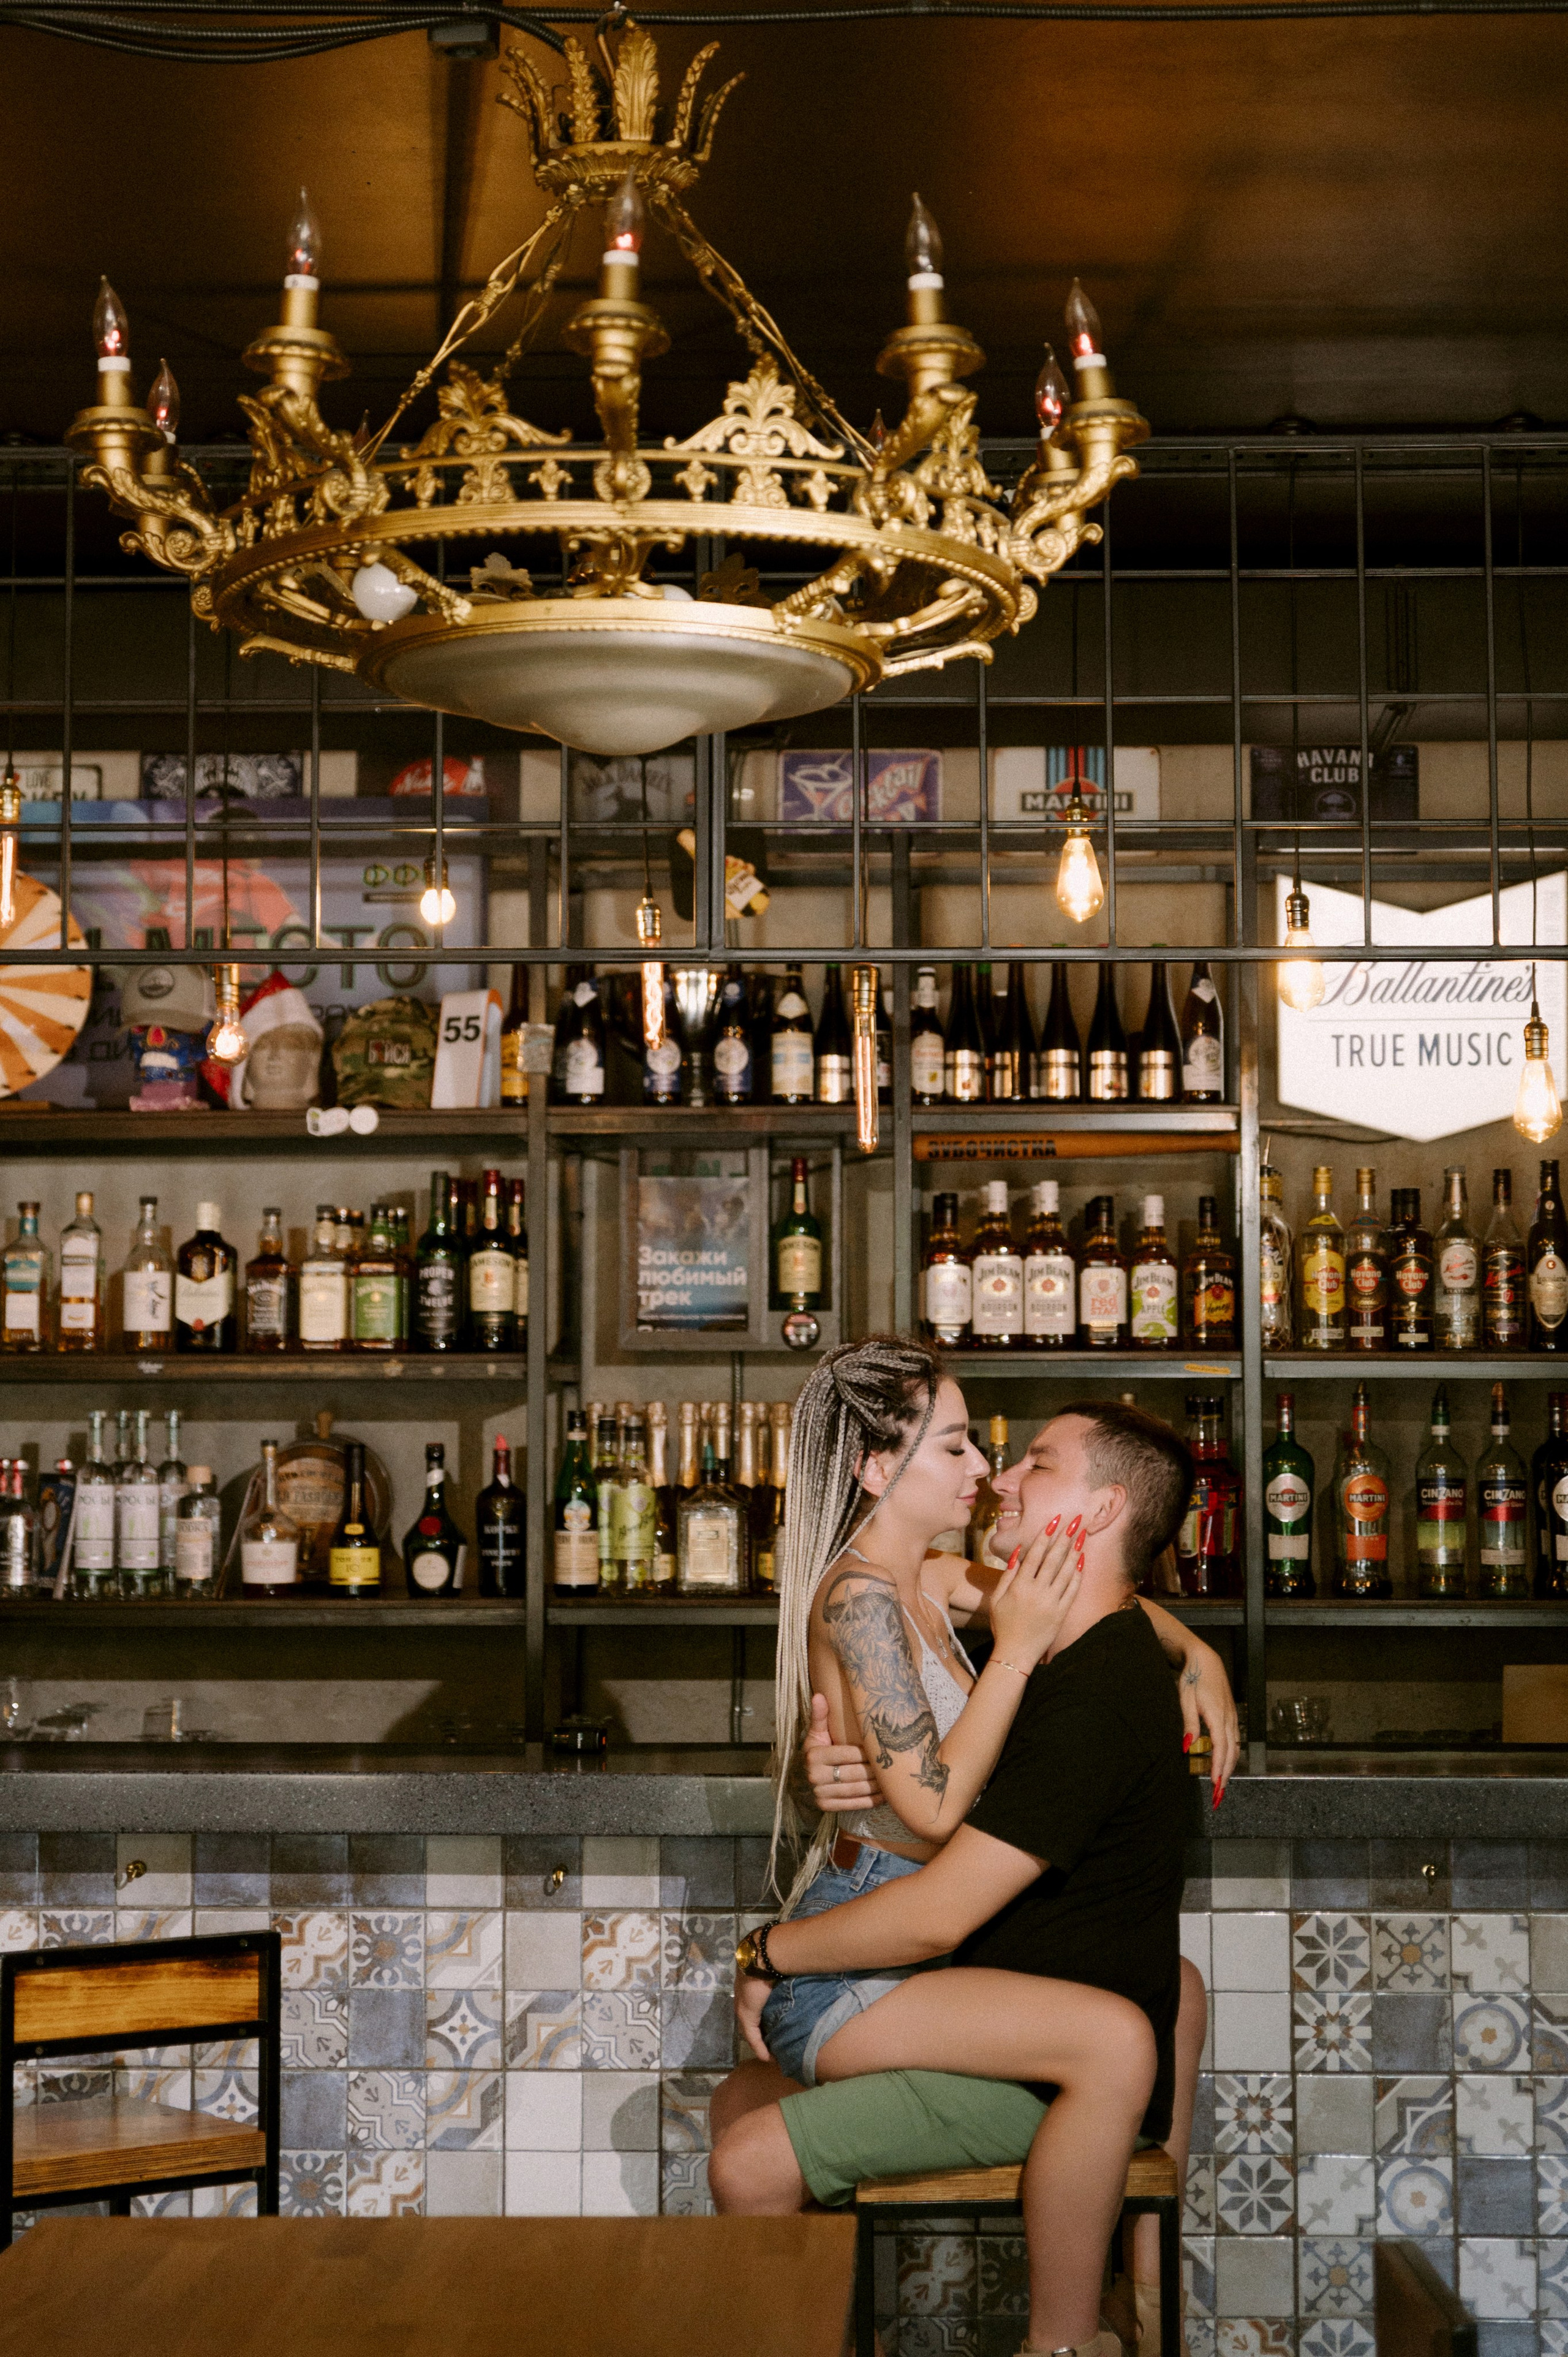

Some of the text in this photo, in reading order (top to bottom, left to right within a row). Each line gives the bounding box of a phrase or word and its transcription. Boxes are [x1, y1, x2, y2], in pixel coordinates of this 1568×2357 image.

[1311, 766, 1360, 784] CLUB
[1025, 794, 1129, 809] MATII
[1316, 950, 1533, 1007] Ballantine's
[443, 1015, 480, 1043] 55
[1332, 1032, 1512, 1067] TRUE MUSIC
[928, 1140, 1057, 1157] ЗУБОЧИСТКА
[638, 1246, 727, 1266] Закажи
[637, 1266, 747, 1286] любимый
[1396, 1271, 1429, 1280] Havana
[1402, 1280, 1423, 1289] Club
[637, 1290, 692, 1310] трек
[1091, 1295, 1117, 1307] red
[1409, 1301, 1418, 1312] 7
[1349, 1494, 1385, 1502] MARTINI
[1421, 1486, 1464, 1500] CINZANO
[1484, 1488, 1526, 1501] CINZANO
